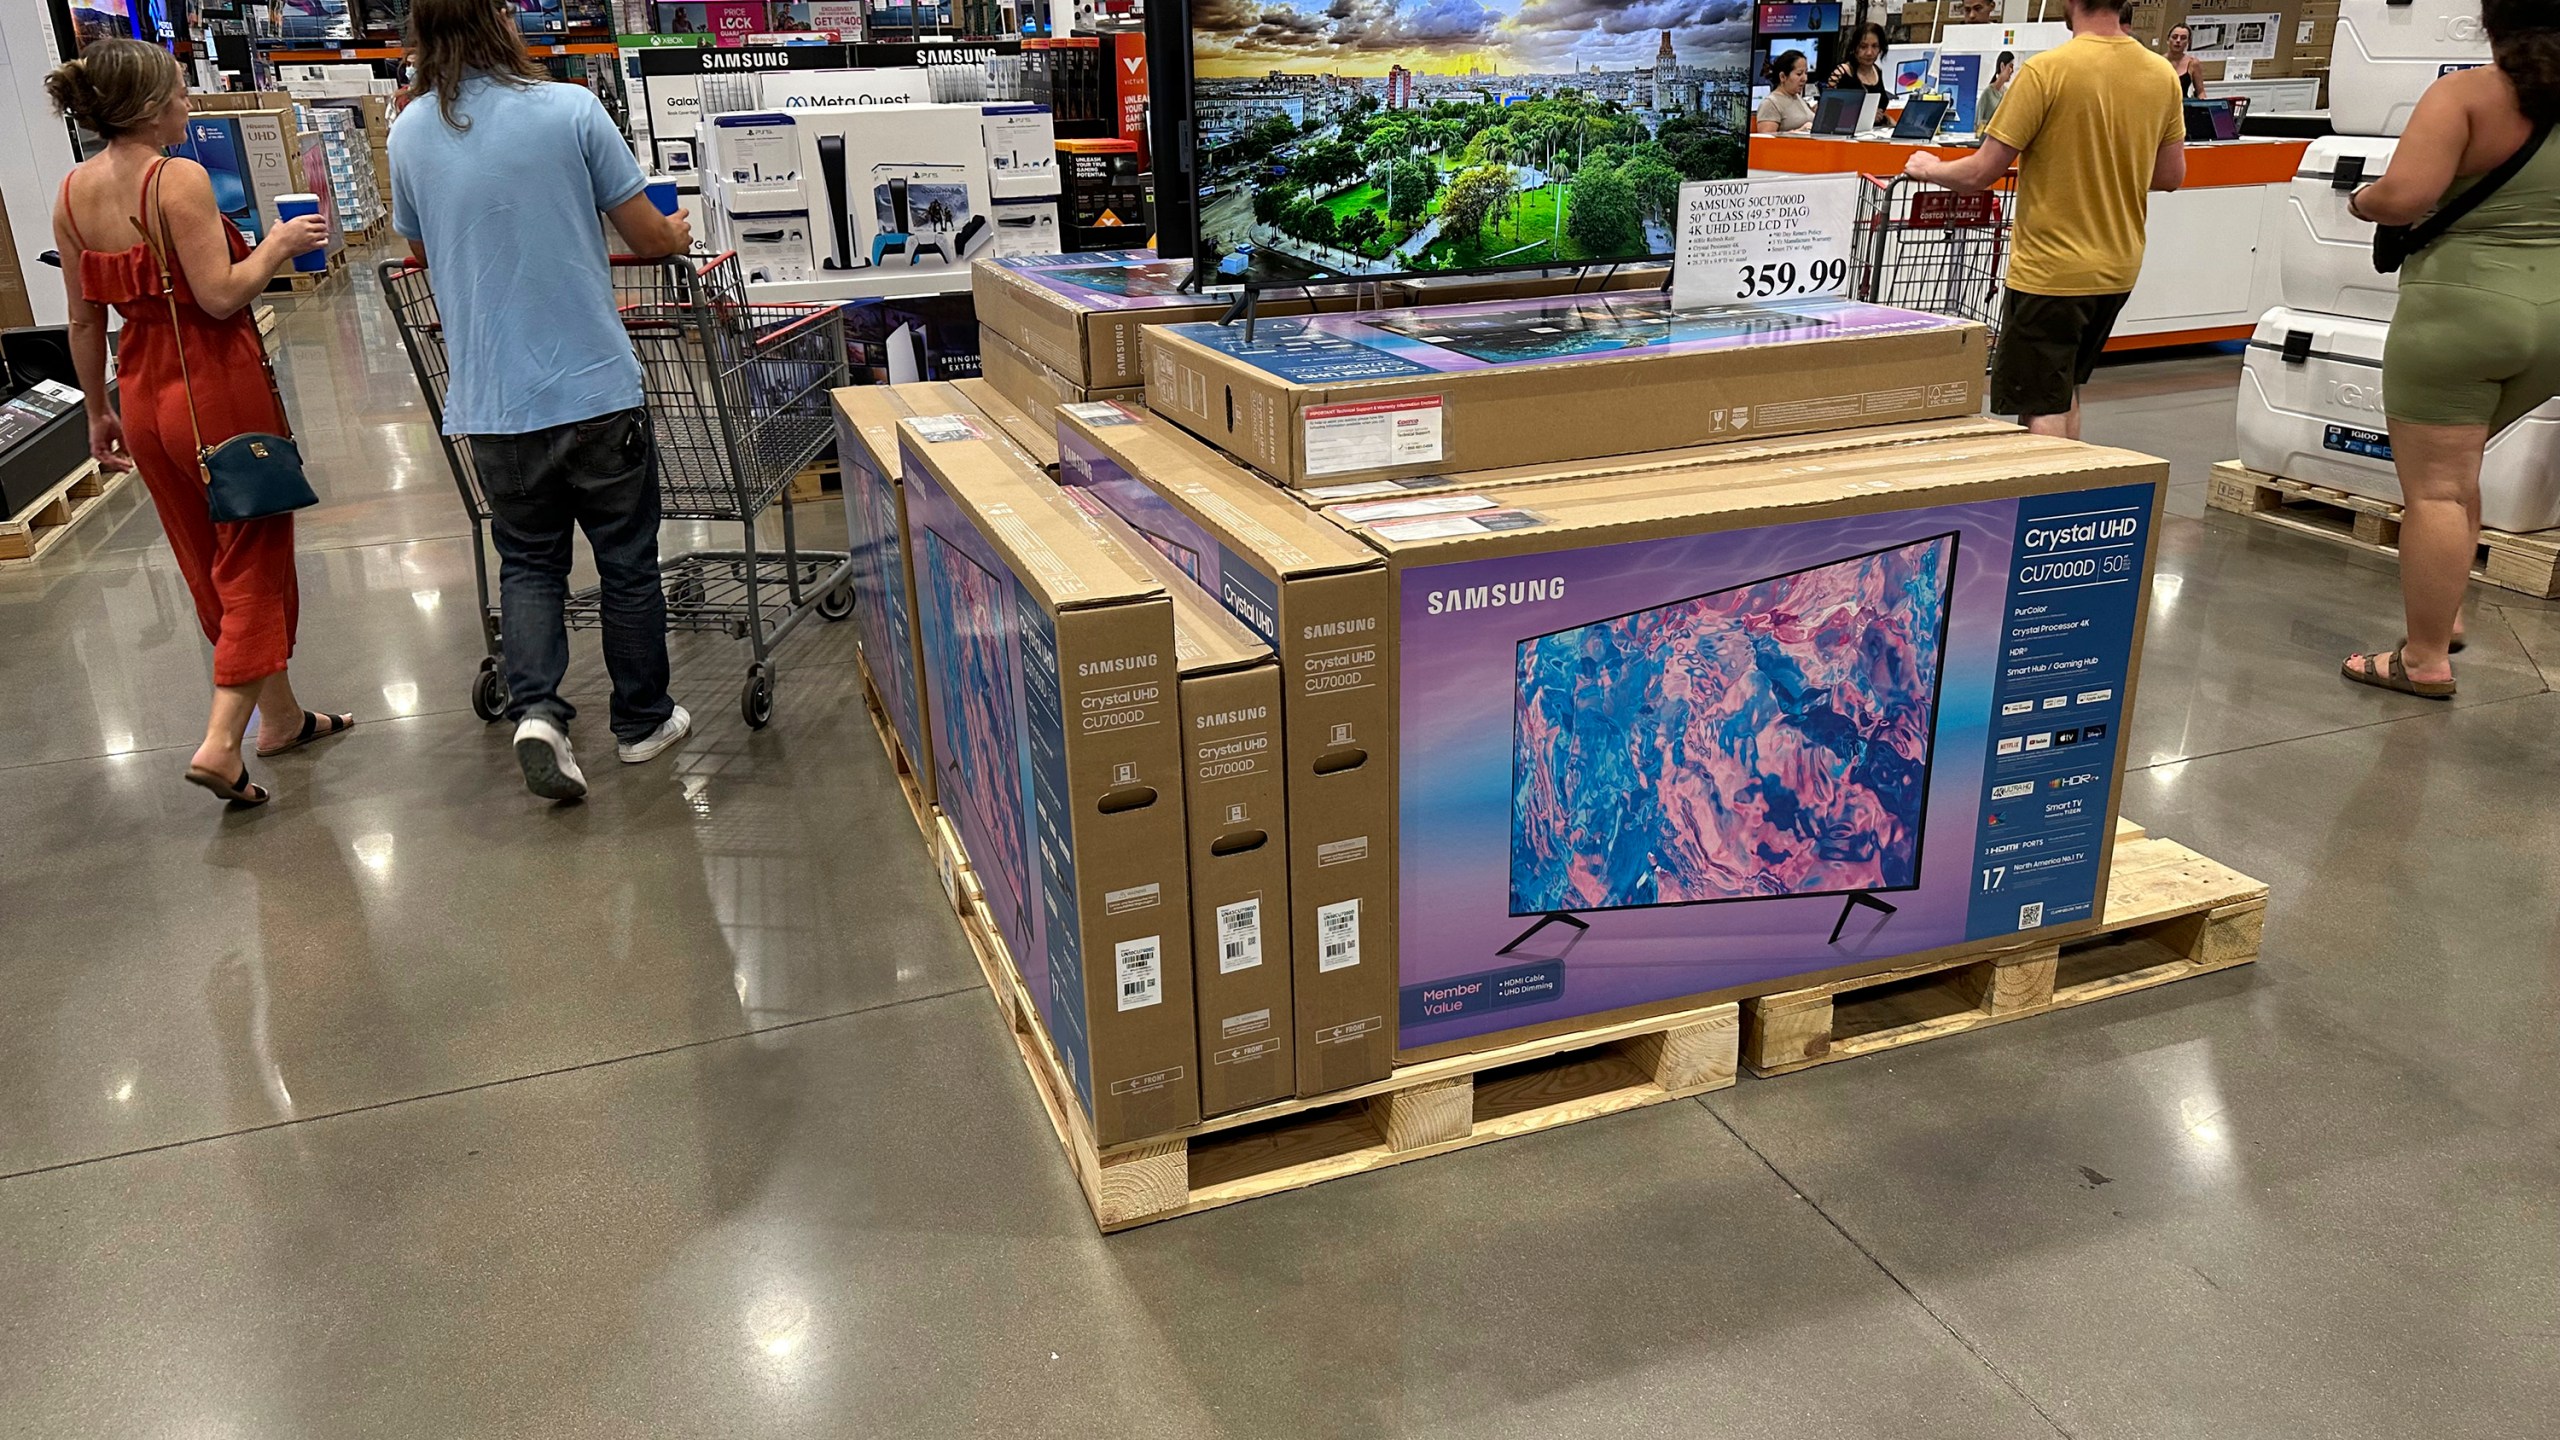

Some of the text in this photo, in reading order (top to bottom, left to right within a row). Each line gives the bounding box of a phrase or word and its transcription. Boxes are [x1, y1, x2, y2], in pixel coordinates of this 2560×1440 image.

[724, 8, 746, 16] PRICE
[720, 17, 752, 30] LOCK
[814, 16, 862, 26] GET $400
[661, 35, 684, 44] XBOX
[702, 52, 789, 69] SAMSUNG
[916, 49, 997, 65] SAMSUNG
[811, 92, 911, 107] Meta Quest
[1124, 95, 1150, 105] UNLEA
[1125, 105, 1143, 113] YOUR
[248, 131, 277, 141] UHD
[1704, 183, 1749, 197] 9050007
[1690, 194, 1805, 212] SAMSUNG 50CU7000D
[1689, 206, 1810, 225] 50" CLASS (49.5" DIAG)
[1945, 211, 1981, 219] WOLESALE
[1688, 218, 1799, 236] 4K UHD LED LCD TV
[1736, 257, 1847, 299] 359.99
[1115, 323, 1126, 377] SAMSUNG
[941, 354, 981, 365] BRINGIN
[1268, 397, 1276, 465] SAMSUNG
[2351, 430, 2379, 441] IGLOO
[1064, 444, 1093, 482] SAMSUNG
[2024, 517, 2137, 551] Crystal UHD
[2019, 558, 2096, 584] CU7000D
[2103, 555, 2123, 573] 50
[1427, 576, 1565, 615] SAMSUNG
[1224, 583, 1274, 638] Crystal UHD
[2014, 605, 2048, 617] PurColor
[1303, 617, 1376, 640] SAMSUNG
[2012, 626, 2040, 638] Crystal
[2040, 620, 2079, 633] Processor
[2080, 619, 2090, 628] 4K
[1078, 653, 1158, 677] SAMSUNG
[1304, 650, 1376, 672] Crystal UHD
[2007, 667, 2031, 677] Smart
[2031, 664, 2046, 674] Hub
[2053, 659, 2083, 670] Gaming
[2083, 655, 2099, 665] Hub
[1305, 672, 1362, 691] CU7000D
[1081, 687, 1159, 710] Crystal UHD
[1082, 709, 1145, 729] CU7000D
[1196, 706, 1267, 729] SAMSUNG
[1199, 737, 1268, 759] Crystal UHD
[2000, 741, 2020, 750] NETFLIX
[1199, 759, 1255, 778] CU7000D
[2045, 799, 2083, 812] Smart TV
[2064, 807, 2082, 816] TIZEN
[1990, 843, 2018, 854] HDMI
[2022, 838, 2044, 849] PORTS
[2013, 862, 2033, 871] North
[2033, 857, 2062, 867] America
[2062, 855, 2075, 863] No.1
[1982, 866, 2006, 891] 17
[1504, 974, 1545, 987] HDMI Cable
[1423, 982, 1482, 1002] Member
[1504, 981, 1553, 997] UHD Dimming
[1424, 1000, 1463, 1016] Value
[1345, 1023, 1365, 1033] FRONT
[1243, 1044, 1263, 1055] FRONT
[1143, 1073, 1165, 1085] FRONT
